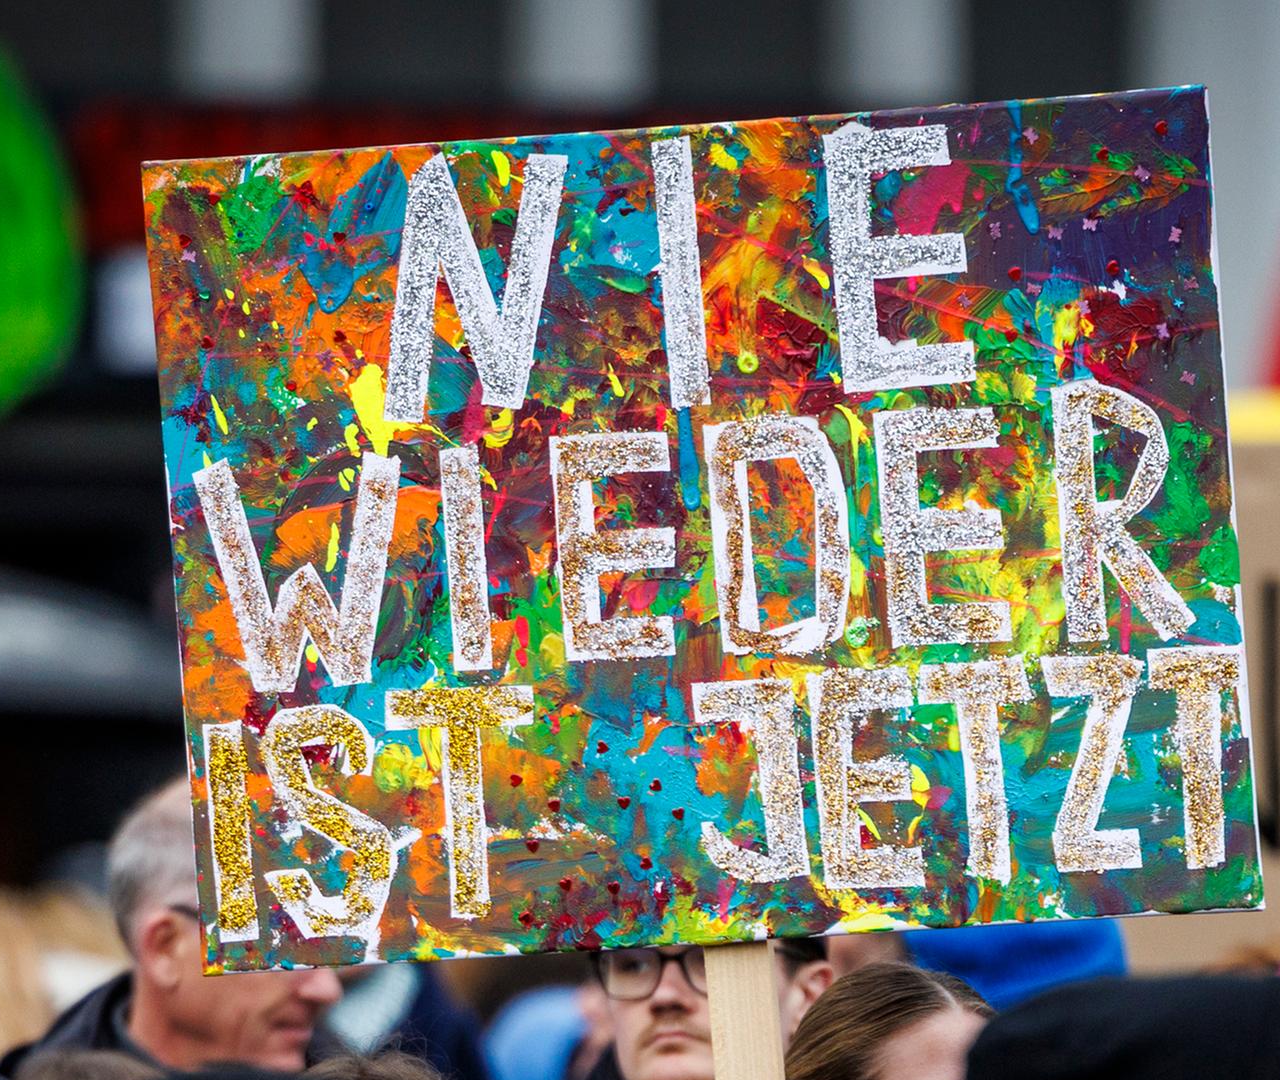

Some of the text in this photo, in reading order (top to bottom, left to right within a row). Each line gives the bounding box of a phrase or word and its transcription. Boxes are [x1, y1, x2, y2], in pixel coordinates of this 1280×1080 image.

[383, 122, 977, 425] NIE
[192, 378, 1198, 694] WIEDER
[202, 644, 1241, 944] IST JETZT
